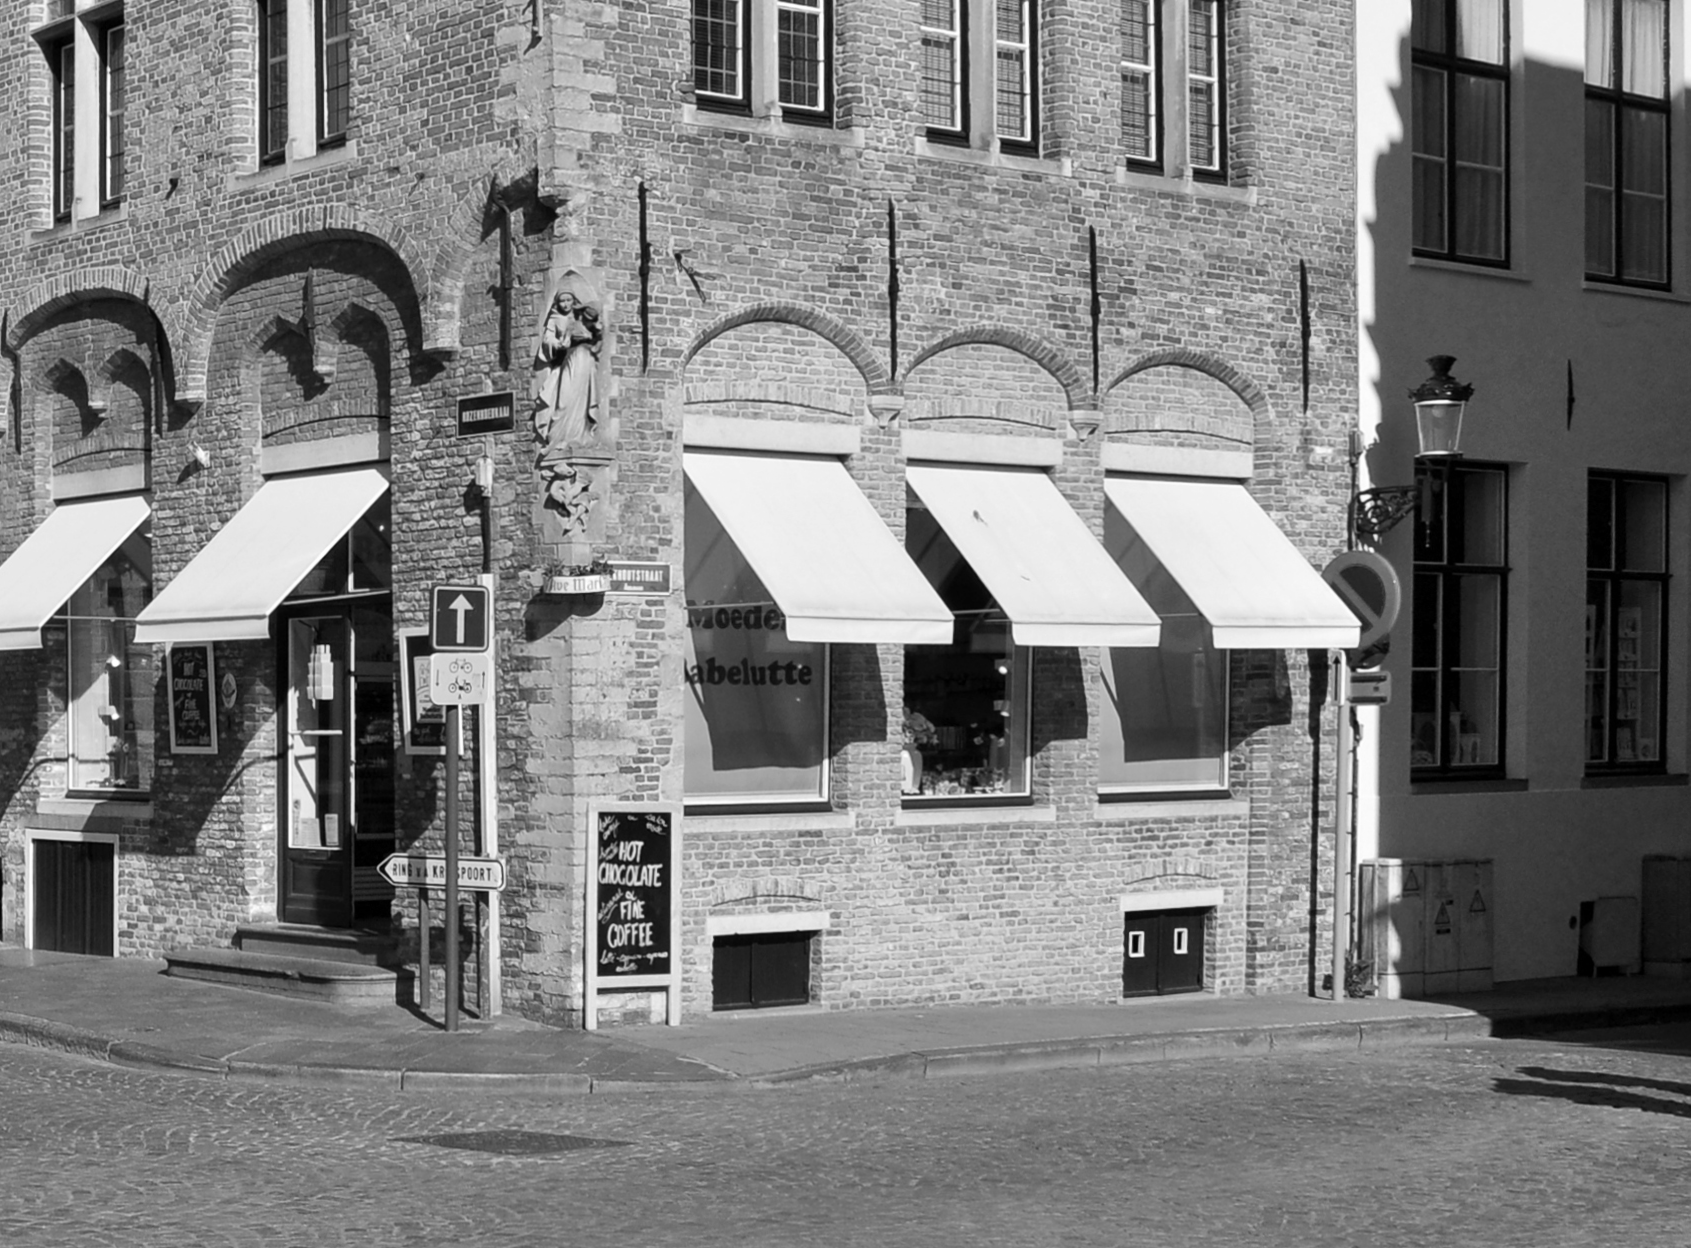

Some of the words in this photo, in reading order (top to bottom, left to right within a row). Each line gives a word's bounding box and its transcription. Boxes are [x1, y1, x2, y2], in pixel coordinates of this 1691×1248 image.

[618, 841, 645, 863] HOT
[392, 862, 413, 878] RING
[598, 861, 664, 888] CHOCOLATE
[619, 899, 646, 921] FINE
[607, 921, 654, 949] COFFEE
